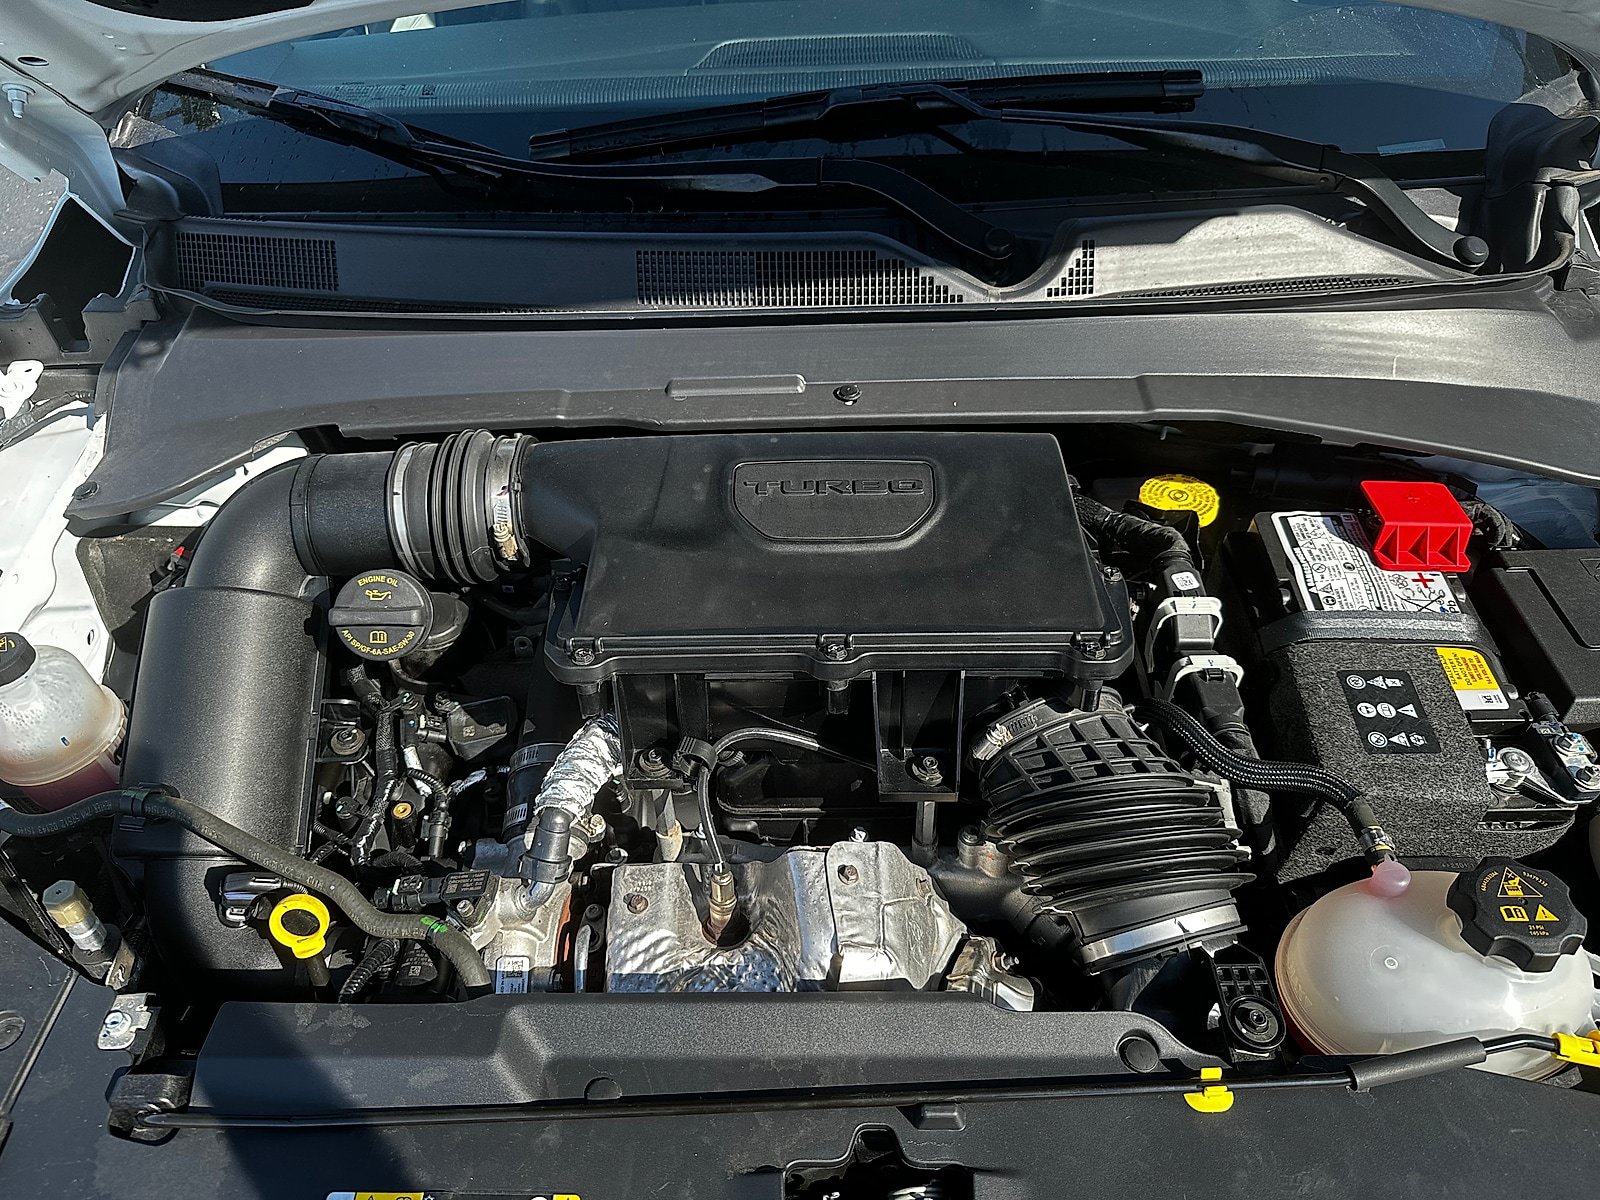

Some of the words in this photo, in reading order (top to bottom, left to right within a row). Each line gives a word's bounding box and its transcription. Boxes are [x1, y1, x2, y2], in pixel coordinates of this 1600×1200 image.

[744, 479, 924, 496] TURBO
[357, 576, 386, 587] ENGINE
[386, 577, 399, 588] OIL
[342, 629, 353, 641] API
[1458, 667, 1468, 677] NOT
